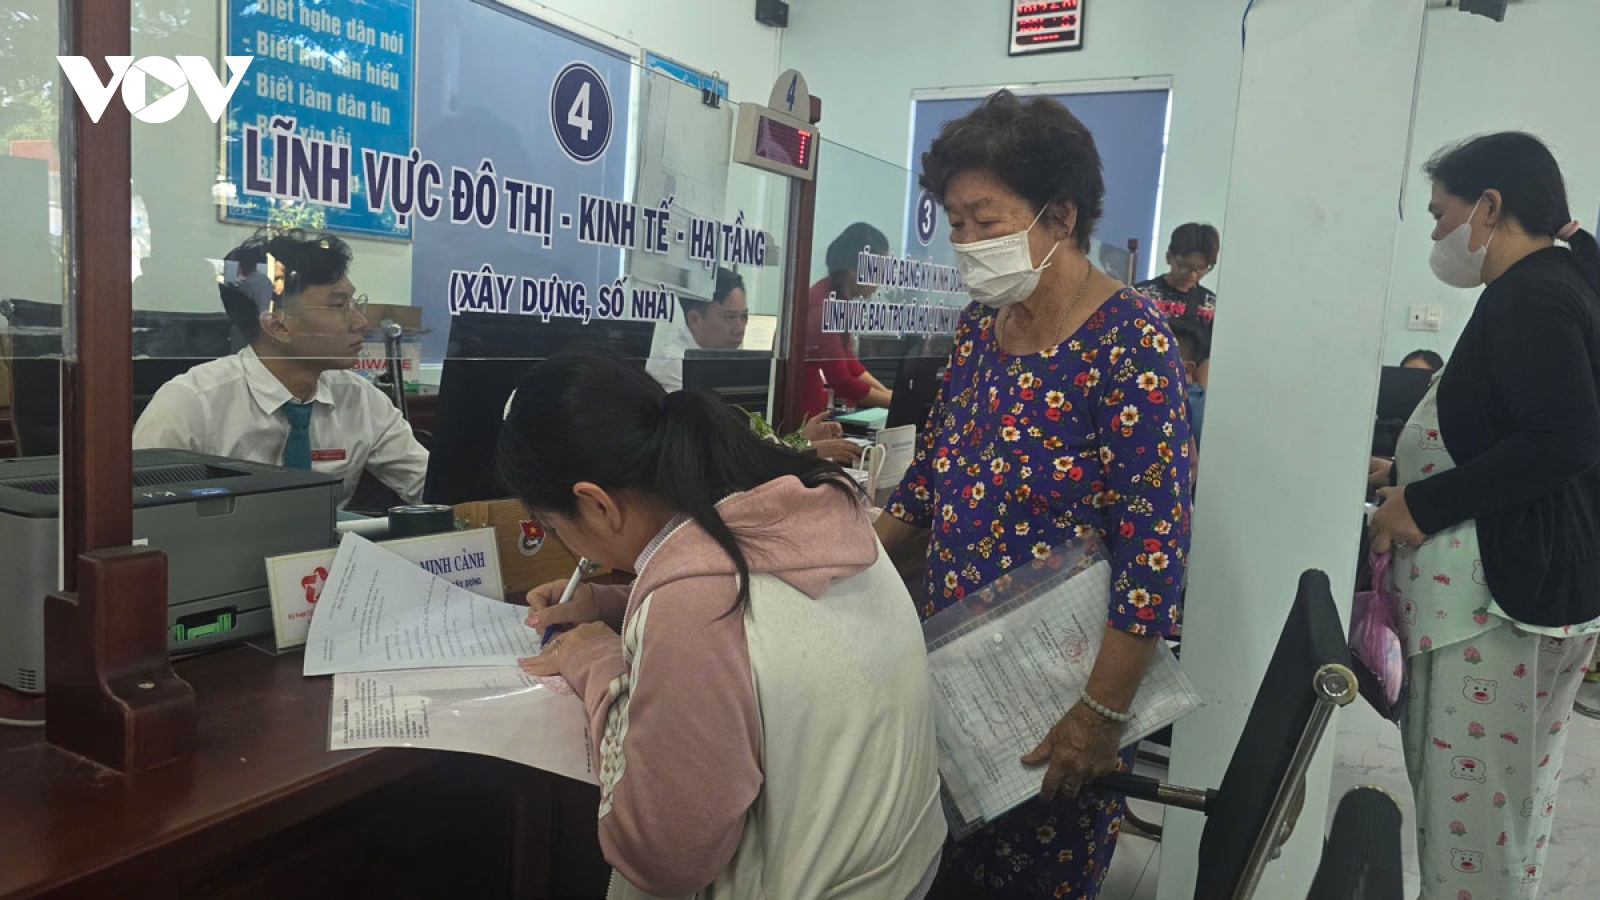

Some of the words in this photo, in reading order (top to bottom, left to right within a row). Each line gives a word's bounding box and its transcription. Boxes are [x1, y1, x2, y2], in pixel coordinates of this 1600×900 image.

[299, 6, 341, 36] nghe
[346, 18, 376, 46] dân
[380, 29, 404, 55] nói
[256, 31, 294, 63] Biết
[365, 61, 400, 91] hiểu
[256, 72, 294, 104] Biết
[299, 83, 332, 112] làm
[336, 93, 367, 120] dân
[371, 101, 391, 125] tin
[567, 81, 593, 141] 4
[786, 74, 798, 112] 4
[245, 116, 351, 207] LĨNH
[363, 149, 442, 226] VỰC
[451, 160, 498, 226] ĐÔ
[504, 179, 553, 248] THỊ
[578, 194, 636, 248] KINH
[643, 195, 674, 253] TẾ
[690, 217, 716, 268] HẠ
[721, 209, 766, 267] TẦNG
[922, 199, 932, 234] 3
[857, 245, 880, 286] LĨNH
[450, 265, 514, 313] (XÂY
[521, 274, 592, 323] DỰNG,
[598, 276, 628, 318] SỐ
[631, 283, 675, 323] NHÀ)
[822, 291, 846, 333] LĨNH
[848, 295, 868, 340] VỰC
[868, 292, 886, 332] BẢO
[420, 556, 452, 575] MINH
[454, 548, 486, 572] CẢNH
